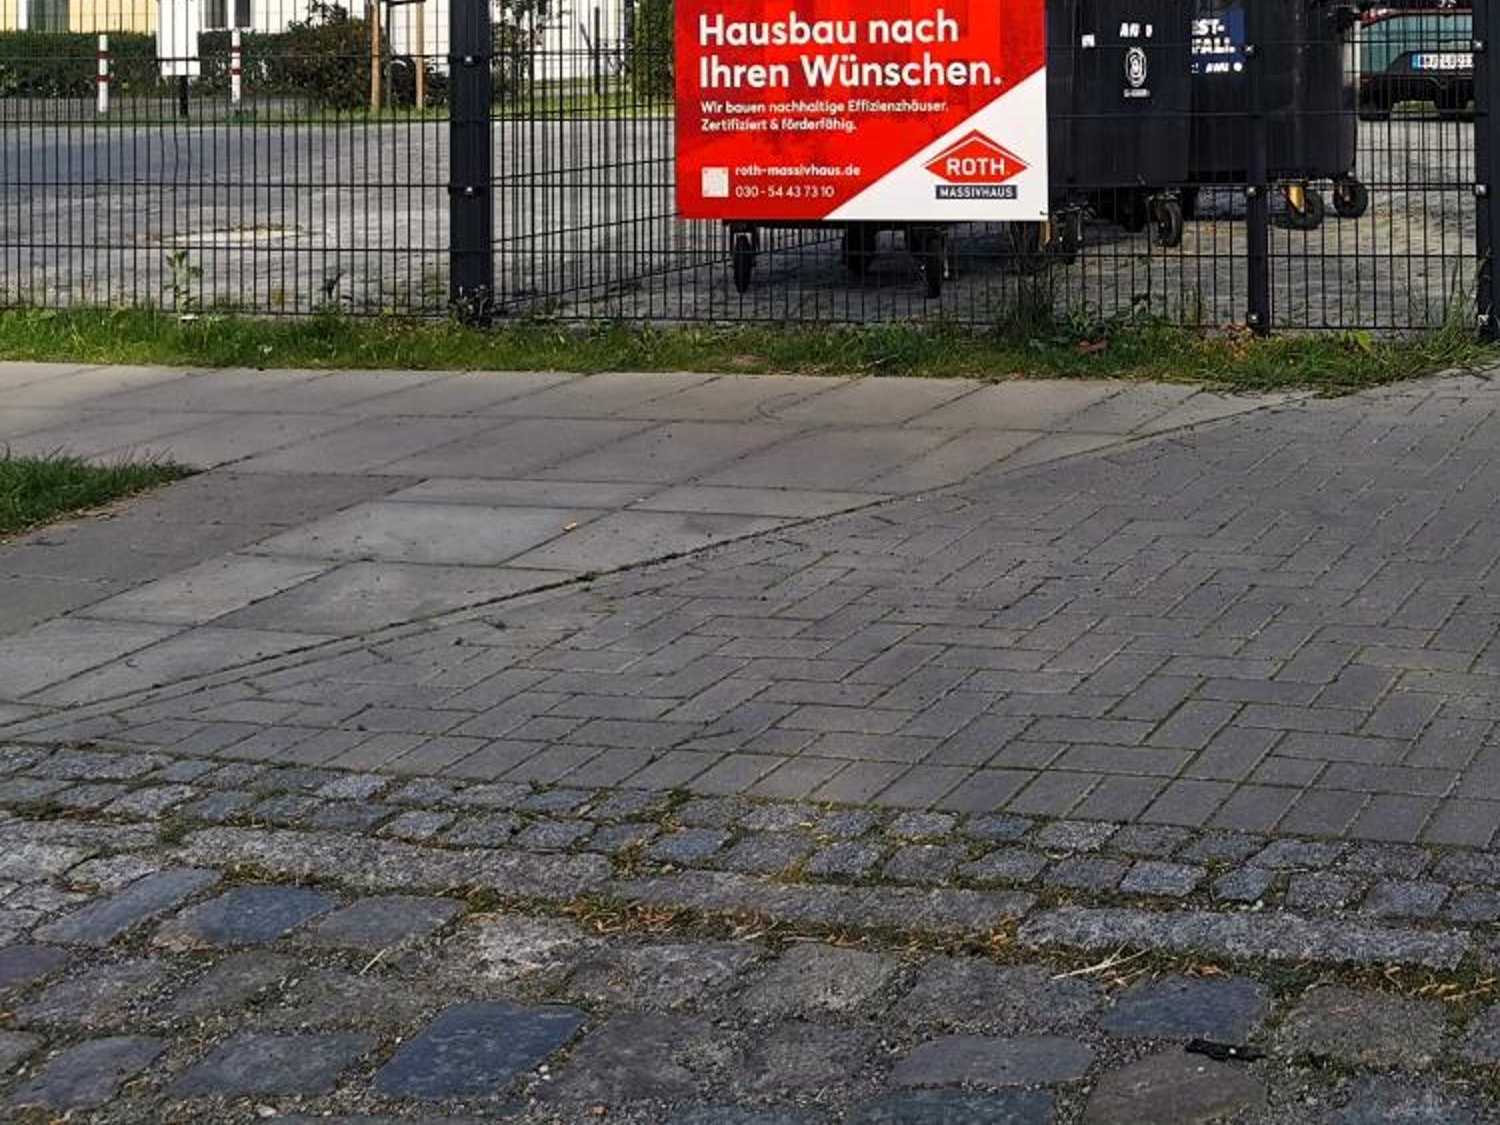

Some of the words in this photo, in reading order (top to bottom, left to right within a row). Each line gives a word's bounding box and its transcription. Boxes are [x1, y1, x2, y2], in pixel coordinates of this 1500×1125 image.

[700, 11, 857, 46] Hausbau
[869, 9, 959, 43] nach
[700, 54, 789, 88] Ihren
[801, 52, 1003, 87] Wünschen.
[701, 101, 723, 114] Wir
[725, 101, 766, 114] bauen
[769, 99, 844, 115] nachhaltige
[848, 99, 949, 113] Effizienzhäuser.
[701, 118, 767, 132] Zertifiziert
[769, 119, 779, 130] &
[781, 117, 857, 133] förderfähig.
[735, 164, 861, 177] roth-massivhaus.de
[946, 157, 1006, 176] ROTH
[939, 186, 1014, 198] MASSIVHAUS
